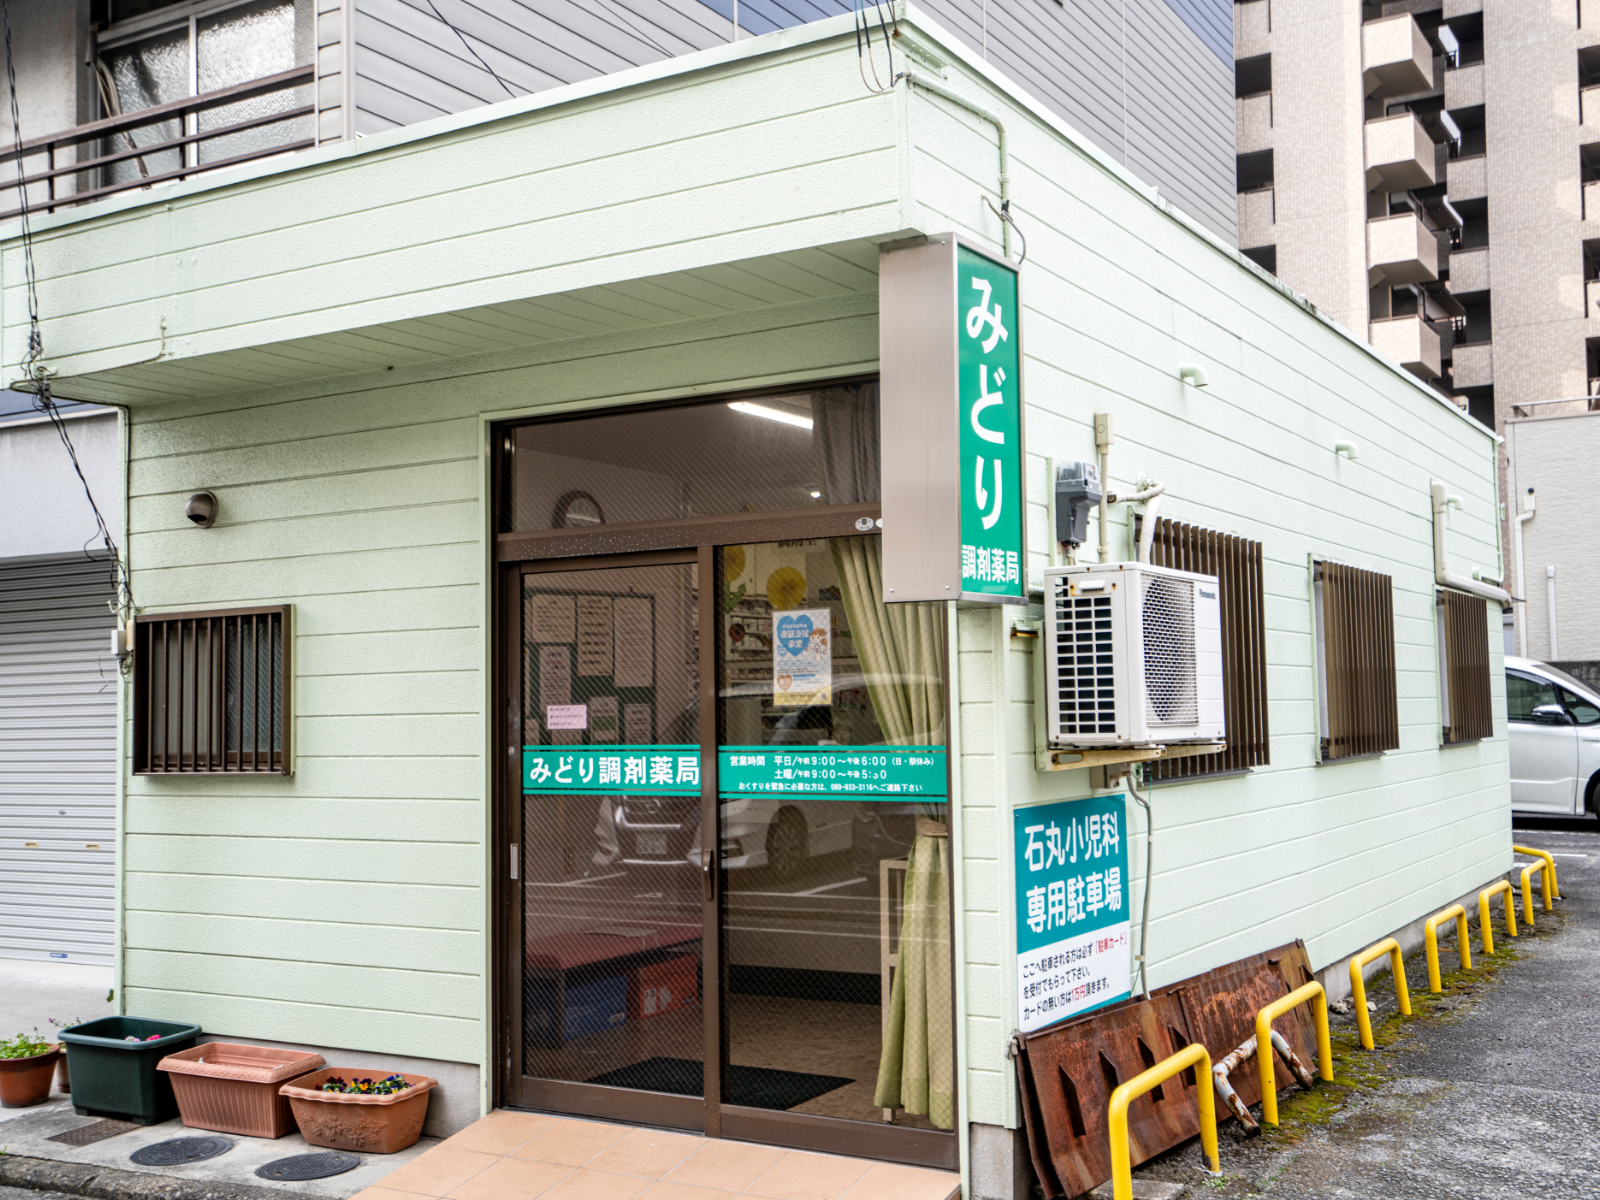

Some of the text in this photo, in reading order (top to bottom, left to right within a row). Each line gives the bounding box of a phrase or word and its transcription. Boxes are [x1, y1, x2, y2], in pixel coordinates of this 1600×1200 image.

[966, 276, 1009, 531] みどり
[961, 544, 1020, 586] 調剤薬局
[1199, 588, 1217, 600] Panasonic
[529, 755, 701, 787] みどり調剤薬局
[729, 755, 766, 767] 営業時間
[1024, 811, 1120, 872] 石丸小児科
[1026, 866, 1122, 934] 専用駐車場
